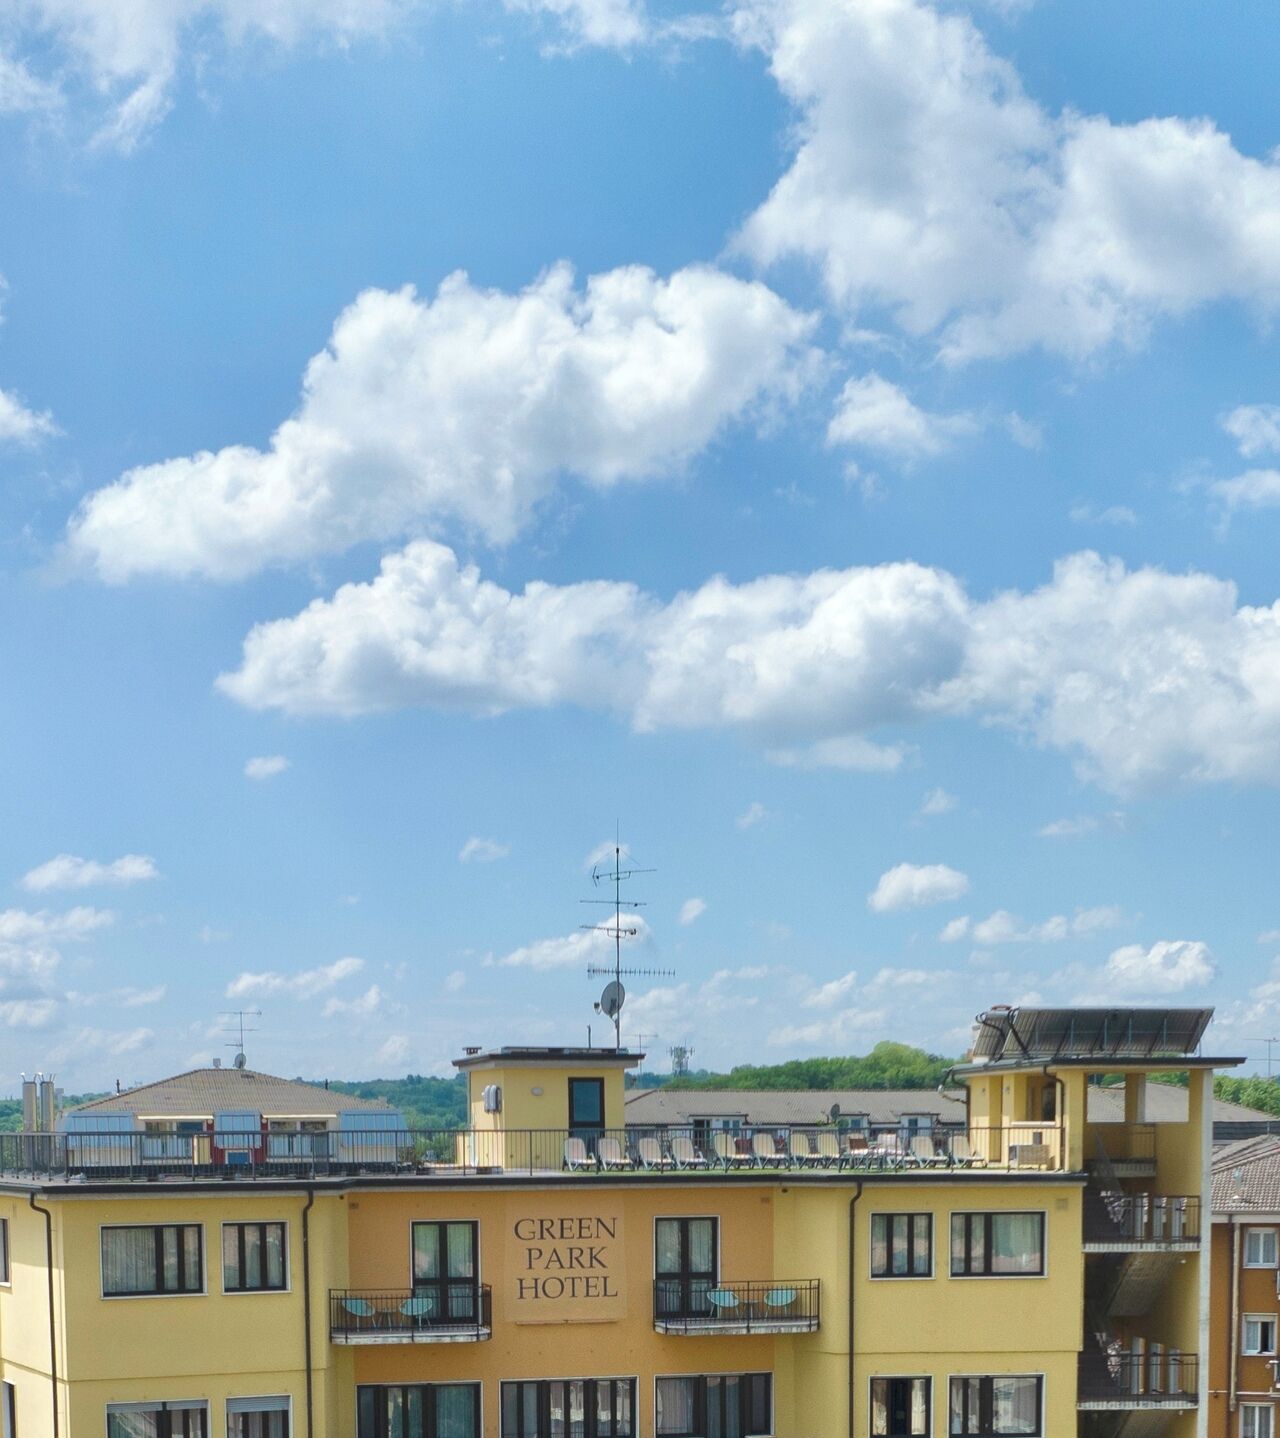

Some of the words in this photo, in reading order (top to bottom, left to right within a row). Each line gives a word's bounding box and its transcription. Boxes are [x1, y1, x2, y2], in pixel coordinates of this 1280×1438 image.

[514, 1217, 618, 1241] GREEN
[526, 1246, 609, 1270] PARK
[516, 1276, 619, 1300] HOTEL
